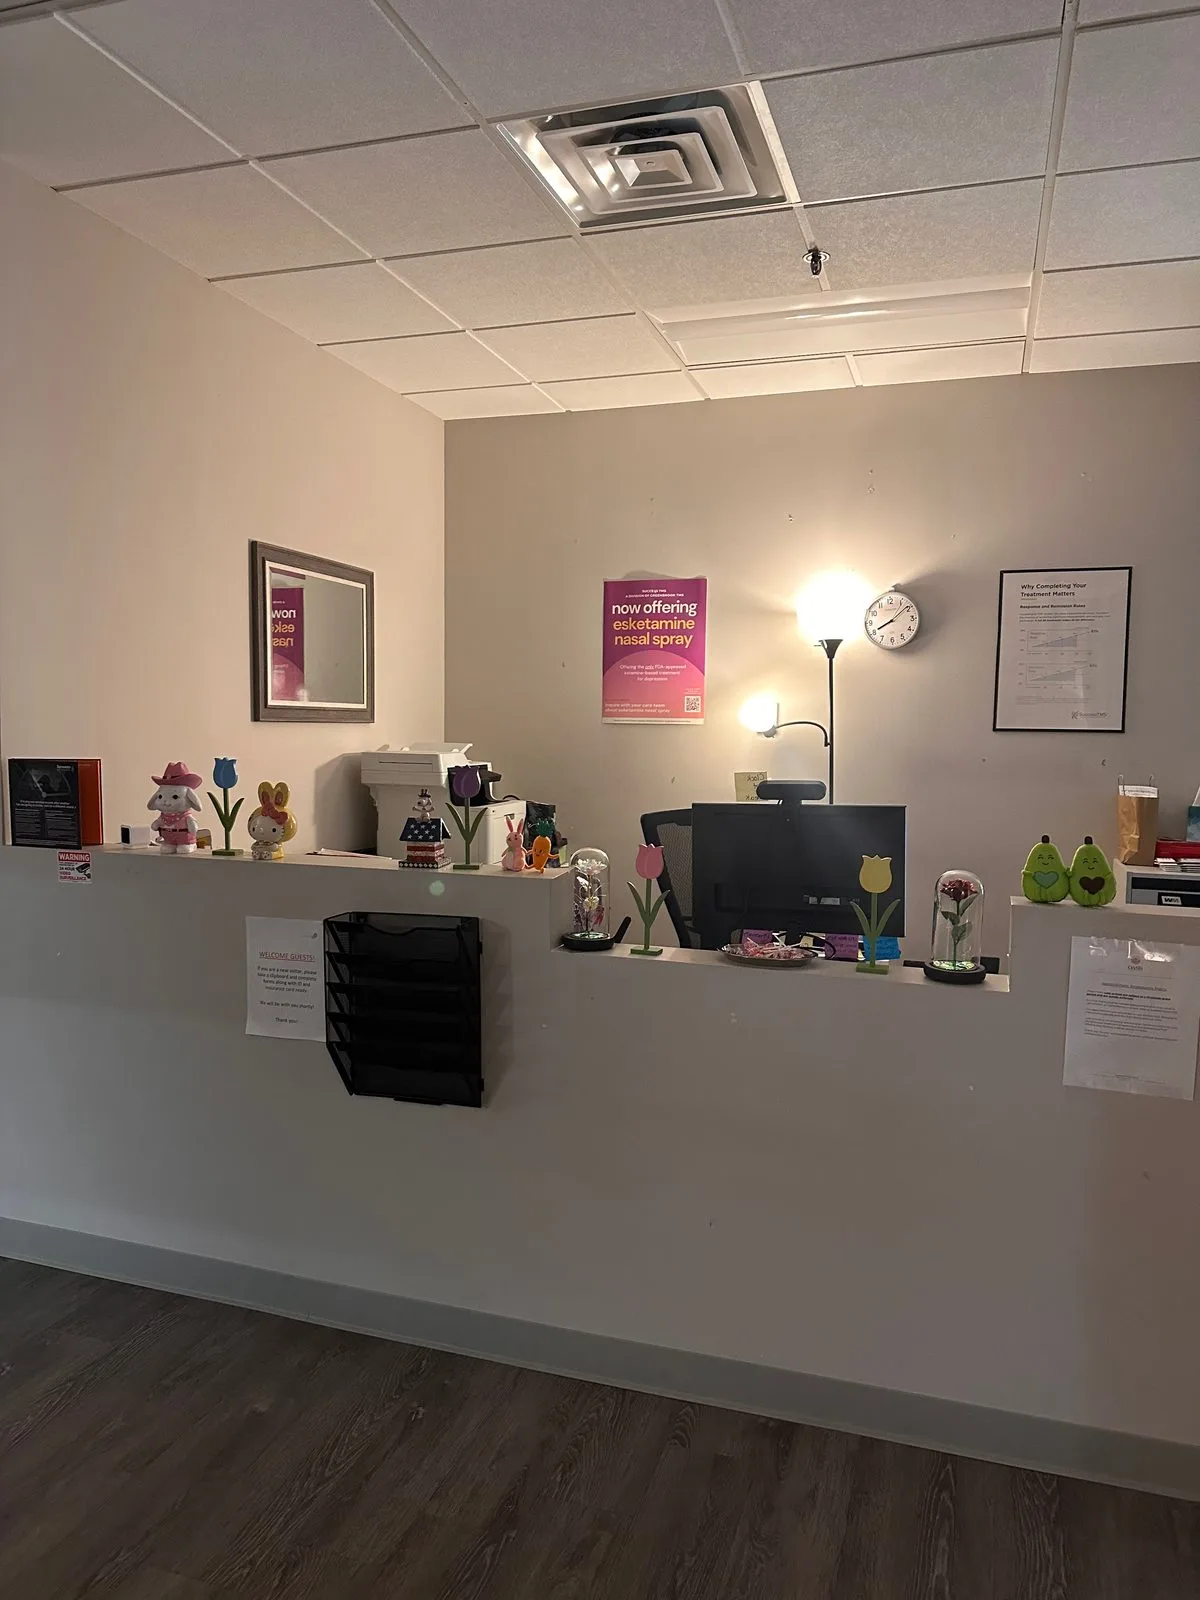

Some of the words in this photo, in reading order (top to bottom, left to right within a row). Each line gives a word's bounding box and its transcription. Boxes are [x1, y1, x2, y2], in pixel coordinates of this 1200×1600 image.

[612, 603, 640, 614] now
[643, 600, 698, 616] offering
[613, 617, 695, 630] esketamine
[614, 632, 649, 645] nasal
[652, 634, 693, 648] spray
[59, 853, 90, 861] WARNING
